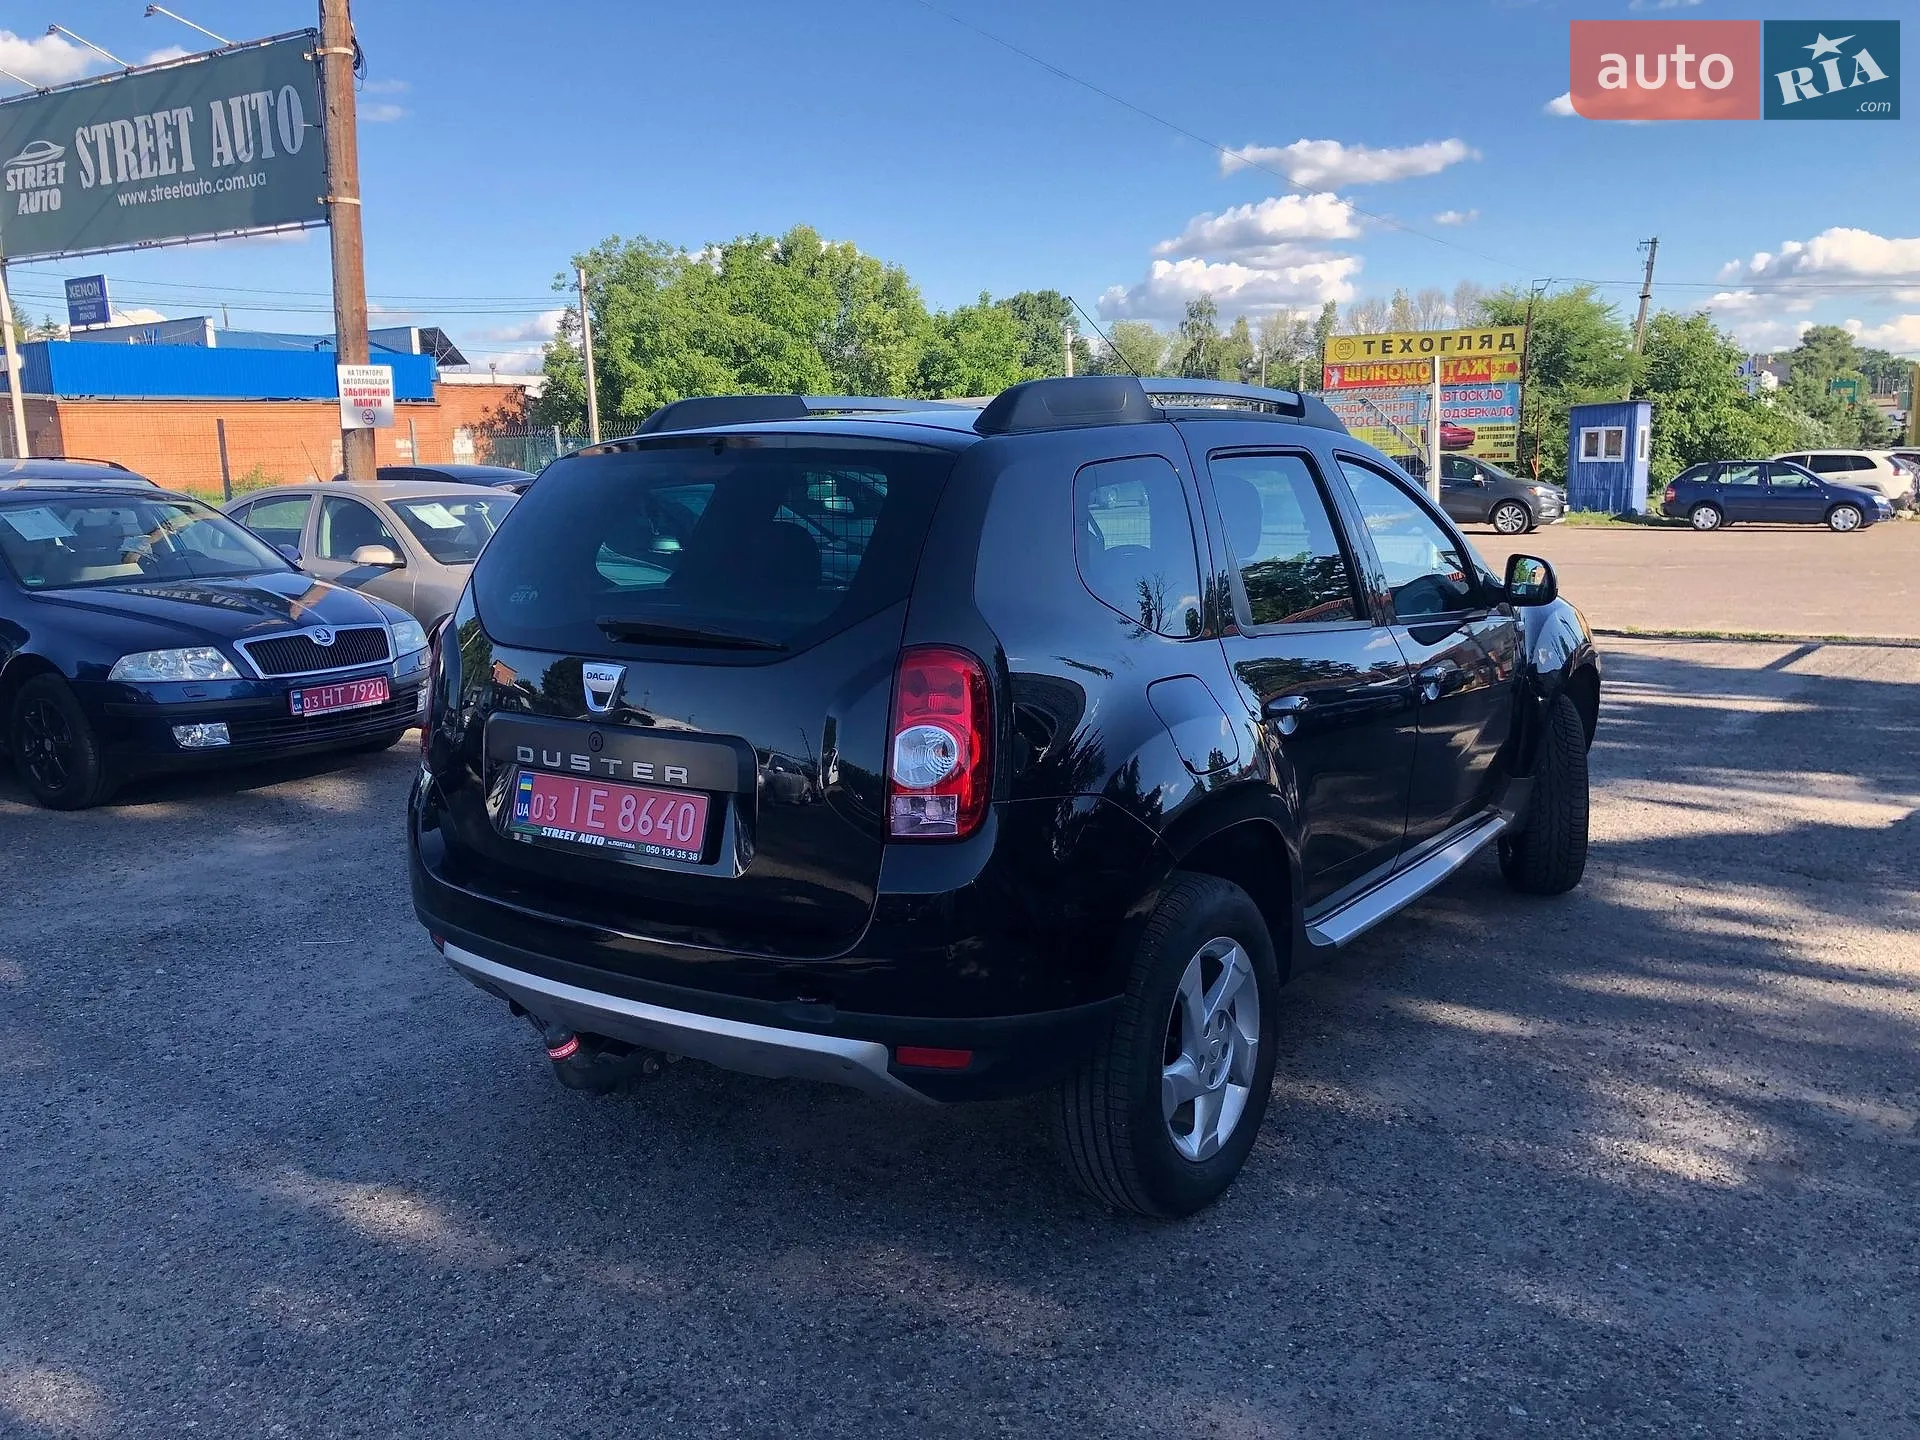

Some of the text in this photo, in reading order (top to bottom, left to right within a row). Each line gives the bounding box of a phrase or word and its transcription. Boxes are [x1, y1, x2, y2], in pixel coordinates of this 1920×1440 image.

[75, 85, 304, 190] STREET AUTO
[6, 161, 65, 192] STREET
[117, 171, 266, 208] www.streetauto.com.ua
[18, 188, 61, 215] AUTO
[1363, 333, 1516, 355] ТЕХОГЛЯД
[1344, 358, 1490, 382] ШИНОМОТАЖ
[343, 387, 390, 397] ЗАБОРОНЕНО
[353, 398, 382, 407] ПАЛИТИ
[586, 671, 615, 681] DACIA
[304, 696, 319, 710] 03
[322, 688, 345, 706] HT
[350, 681, 384, 702] 7920
[516, 745, 689, 784] DUSTER
[516, 802, 529, 817] UA
[532, 793, 559, 822] 03
[617, 794, 696, 842] 8640
[541, 826, 577, 841] STREET
[578, 833, 605, 846] AUTO
[646, 845, 660, 855] 050
[662, 847, 675, 857] 134
[677, 850, 687, 859] 35
[688, 852, 698, 861] 38
